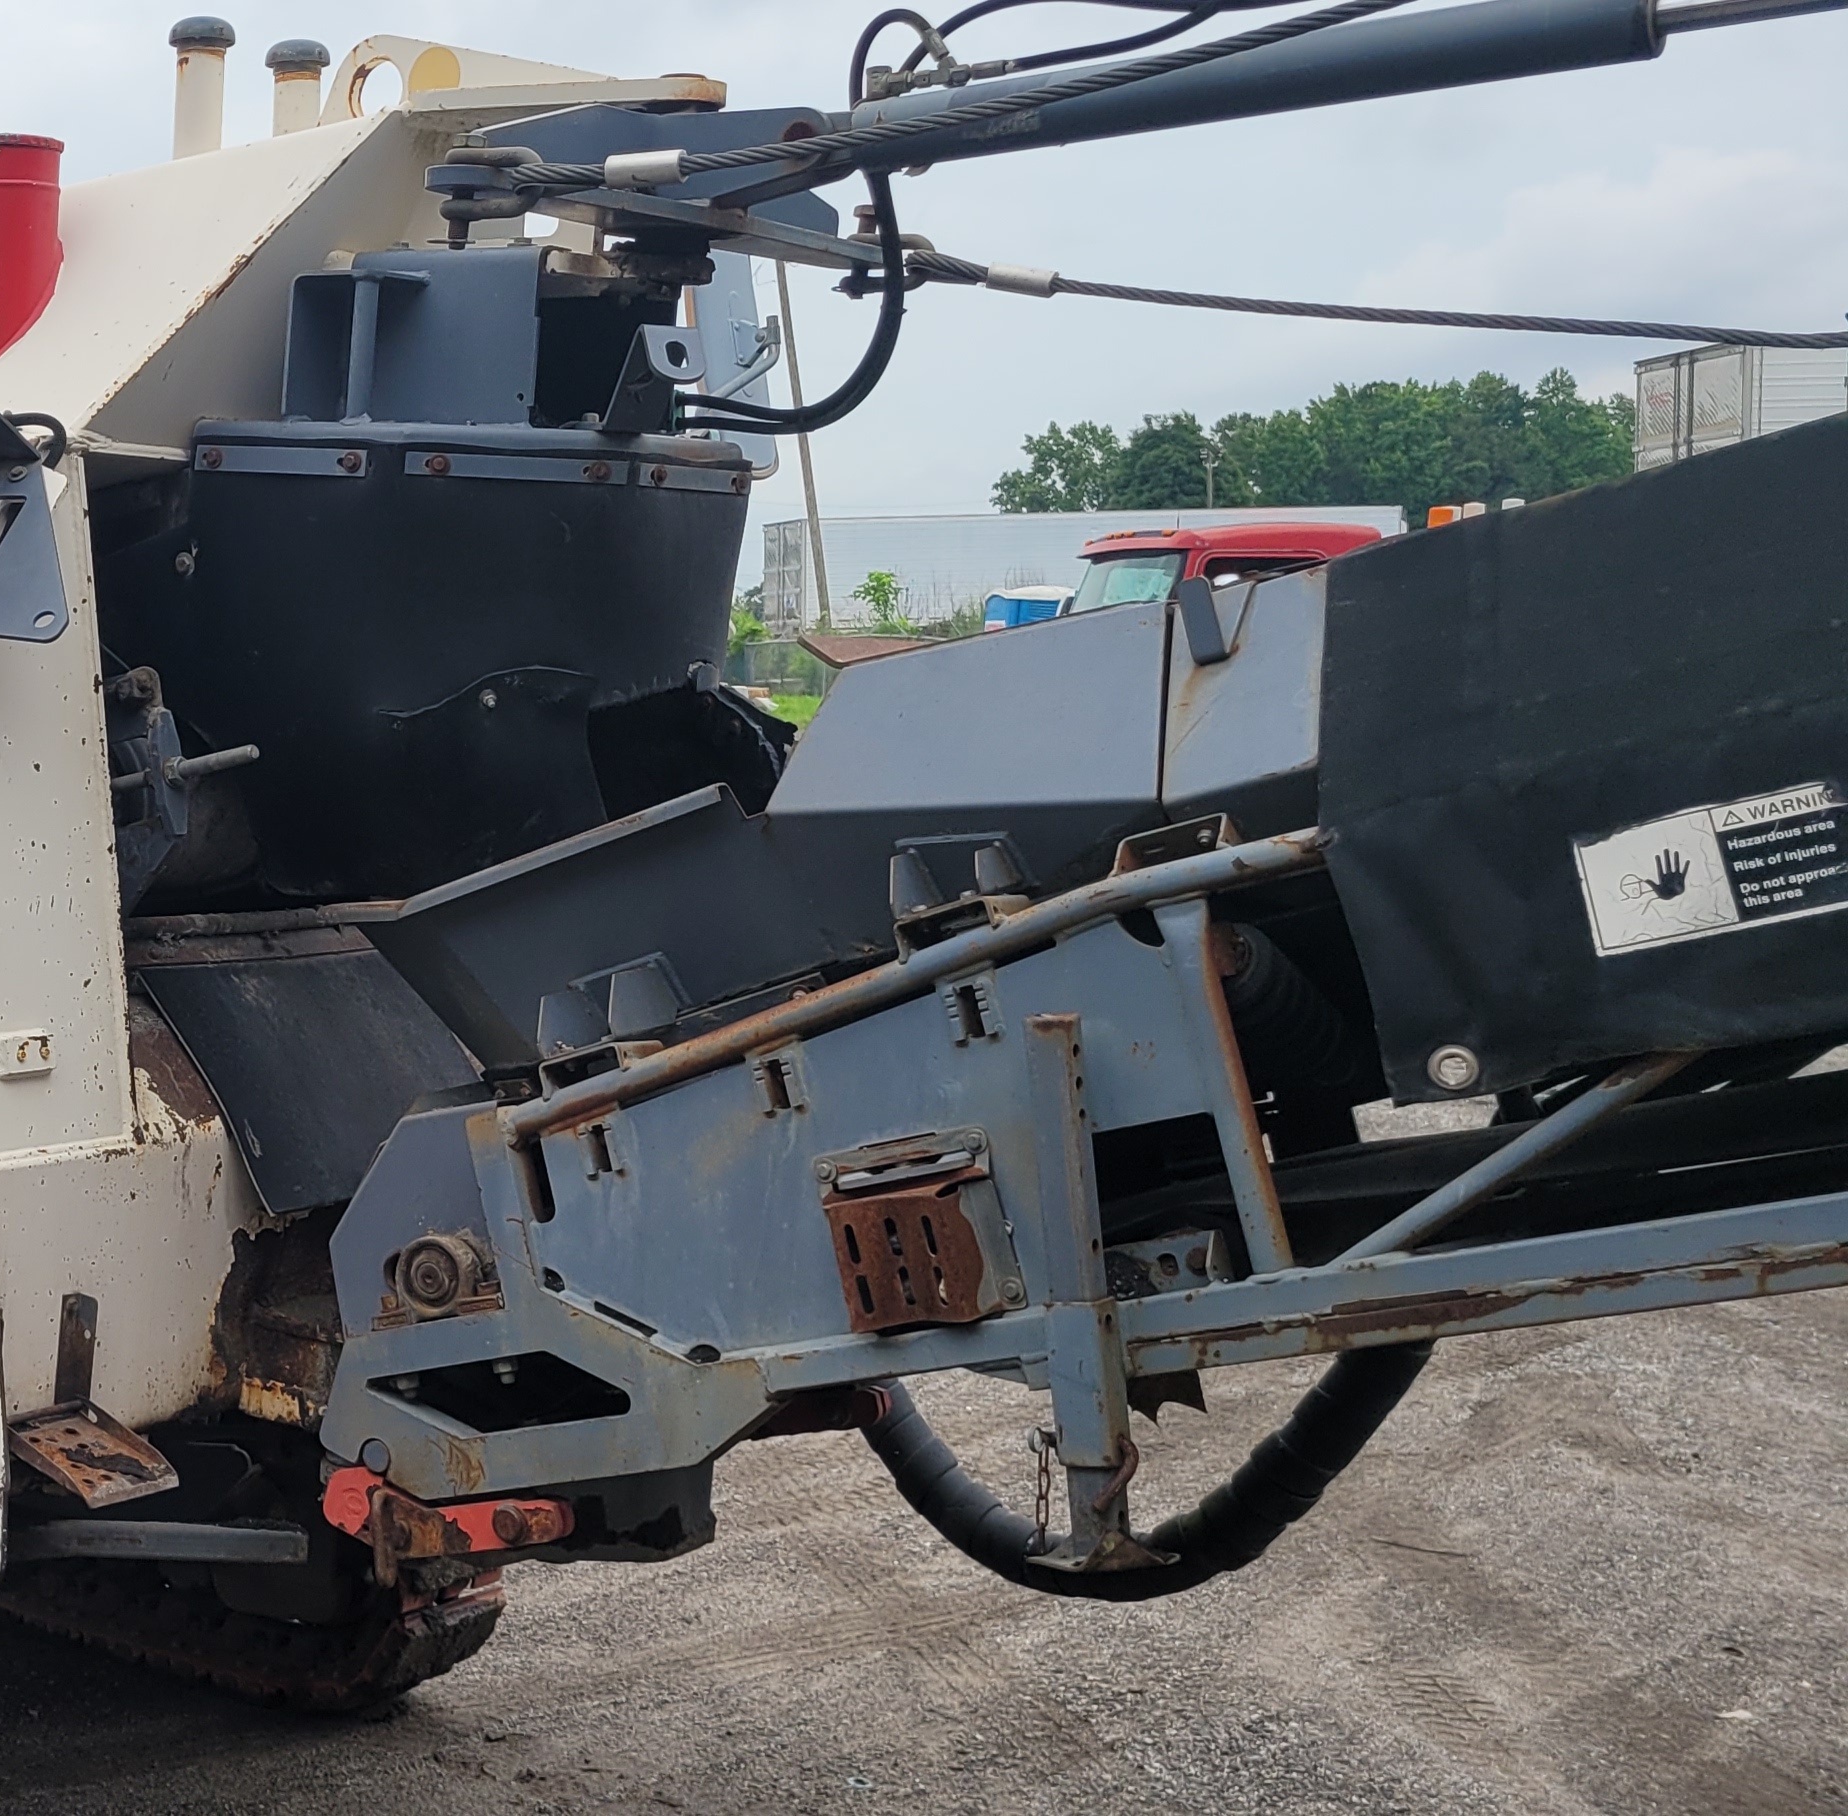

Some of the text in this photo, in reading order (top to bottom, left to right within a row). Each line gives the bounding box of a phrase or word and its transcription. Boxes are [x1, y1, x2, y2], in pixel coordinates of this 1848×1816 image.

[1746, 790, 1834, 820] WARNIN
[1727, 820, 1835, 850] Hazardous area
[1733, 843, 1837, 872] Risk of injuries
[1739, 882, 1760, 894] Do
[1763, 876, 1787, 890] not
[1743, 888, 1803, 907] this area
